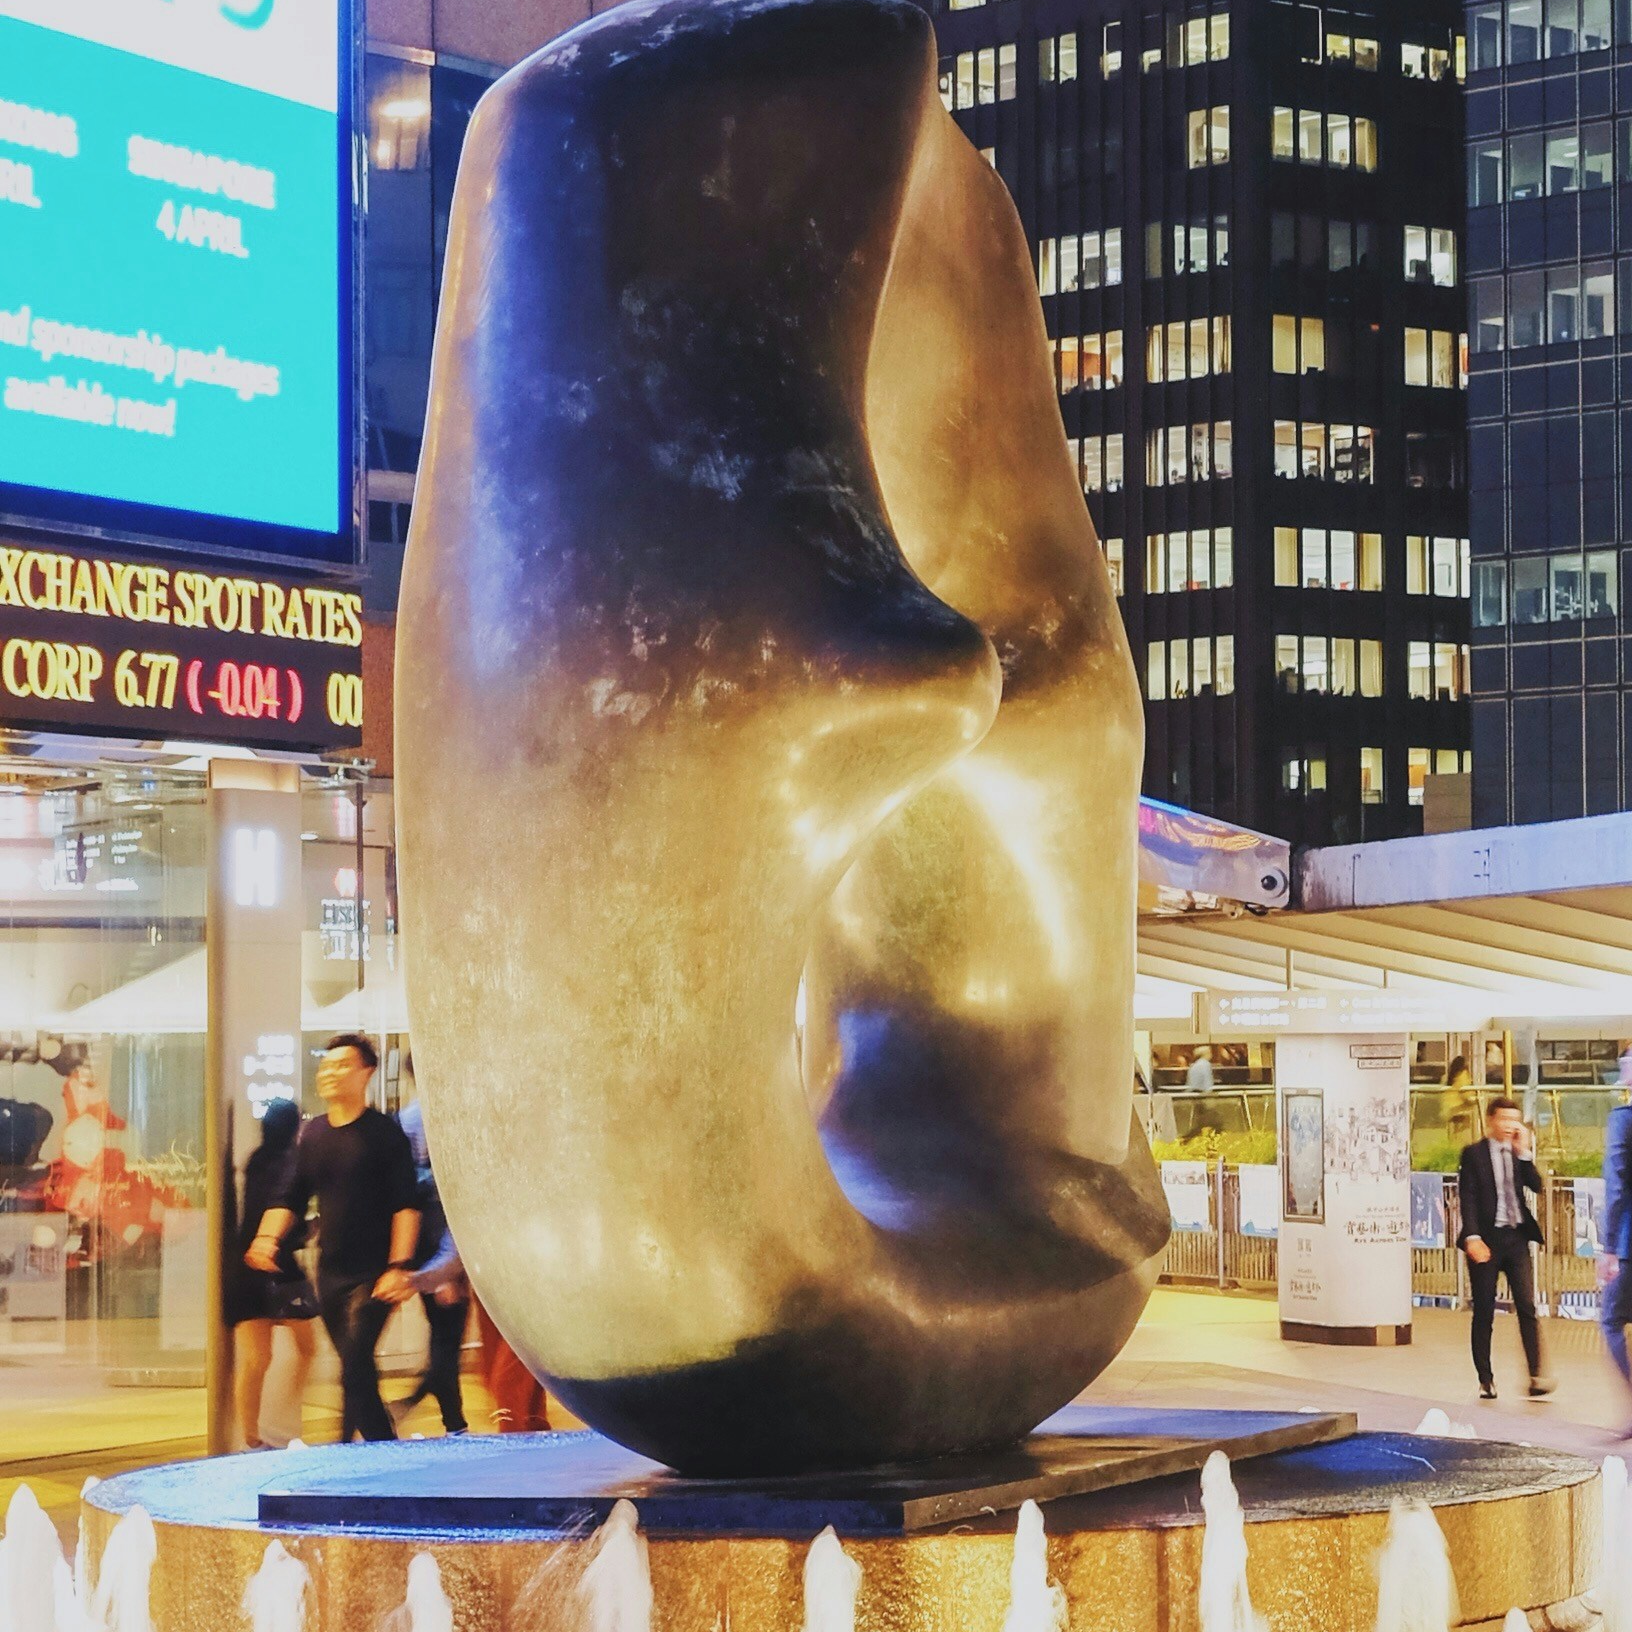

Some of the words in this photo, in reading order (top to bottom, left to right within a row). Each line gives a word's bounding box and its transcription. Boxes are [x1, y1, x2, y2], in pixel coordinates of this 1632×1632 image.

[156, 200, 174, 241] 4
[176, 204, 249, 258] APRIL
[31, 318, 175, 382] sponsorship
[174, 347, 280, 400] packages
[4, 376, 115, 425] available
[173, 571, 258, 634] SPOT
[262, 583, 363, 647] RATES
[2, 638, 103, 703] CORP
[114, 649, 179, 709] 6.77
